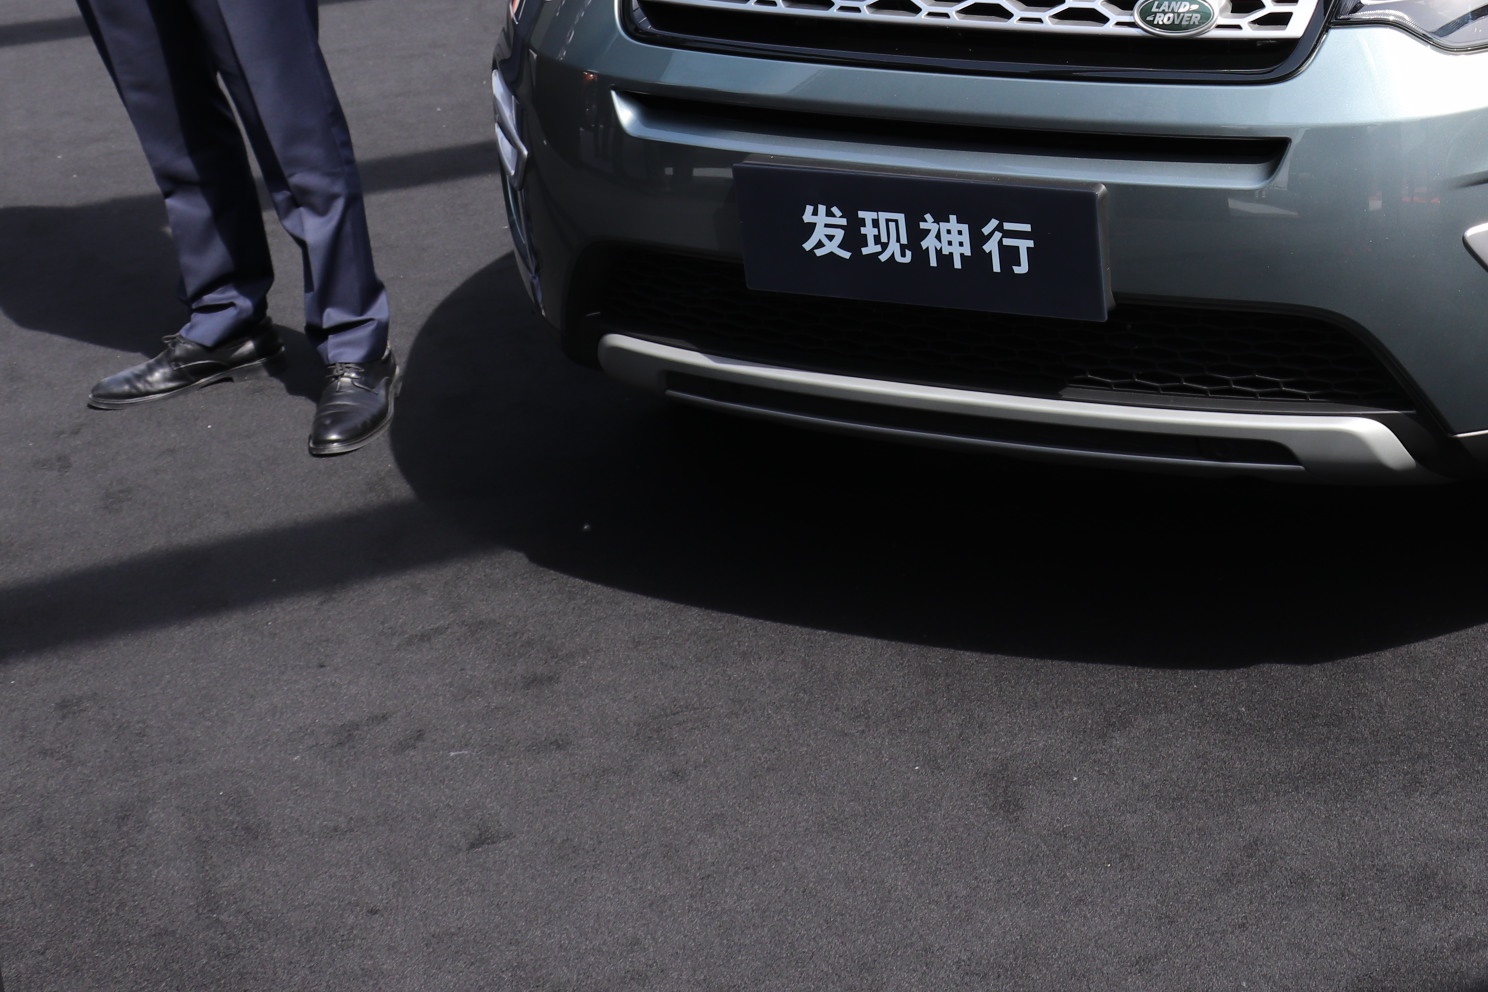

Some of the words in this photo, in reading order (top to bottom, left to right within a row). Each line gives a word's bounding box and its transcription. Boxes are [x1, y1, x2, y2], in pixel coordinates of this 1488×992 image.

[1151, 1, 1190, 12] LAND
[1153, 12, 1201, 25] ROVER
[802, 203, 1035, 275] 发现神行
